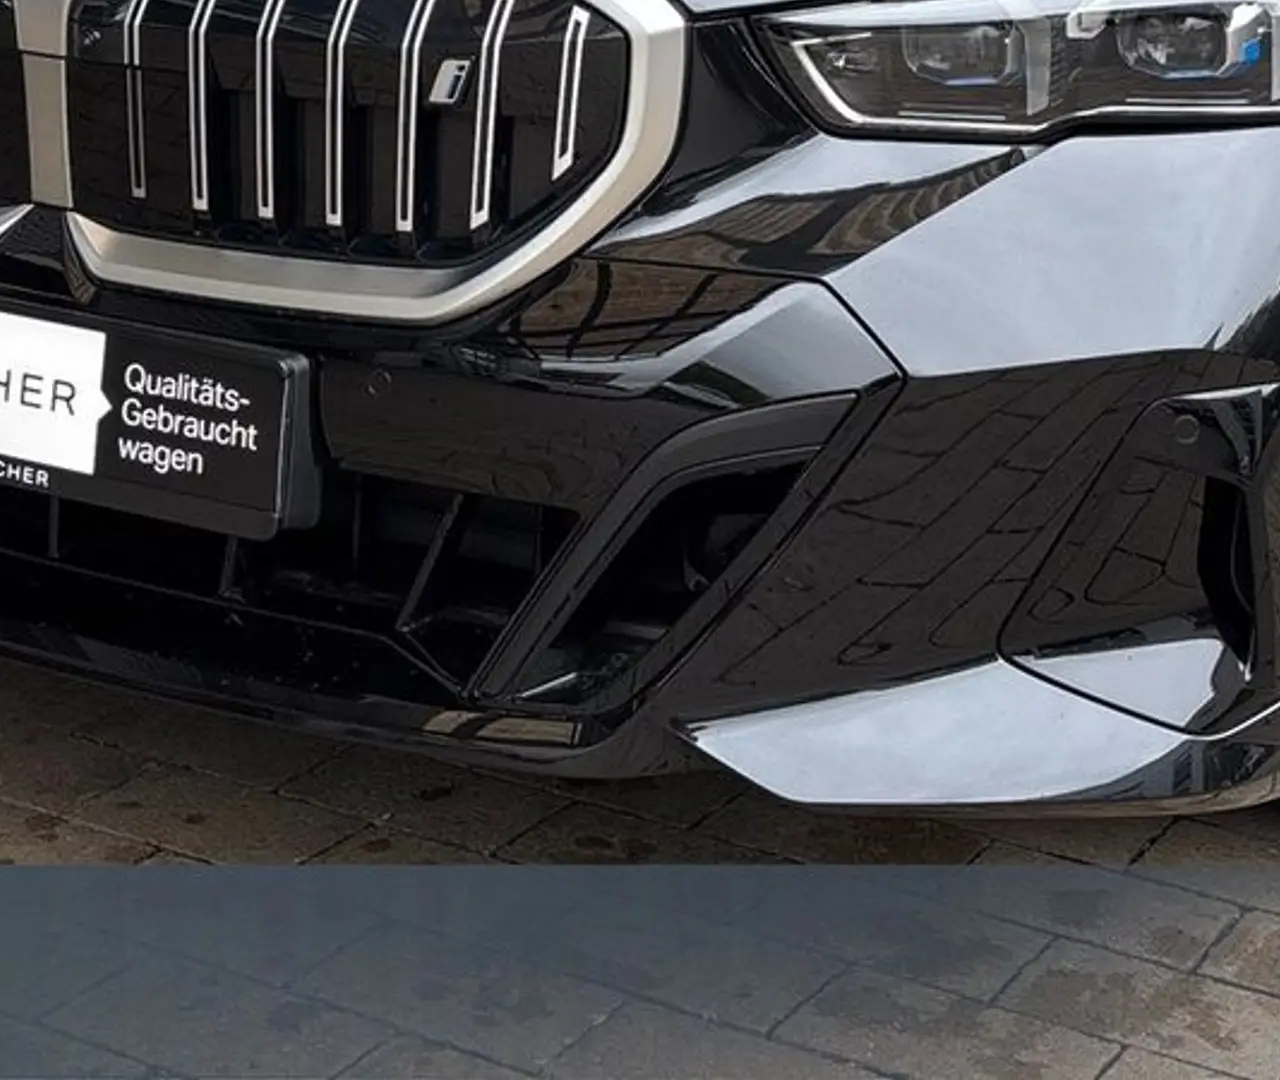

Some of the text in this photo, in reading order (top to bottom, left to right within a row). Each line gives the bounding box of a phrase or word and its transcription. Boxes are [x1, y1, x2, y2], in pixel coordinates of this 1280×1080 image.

[124, 362, 251, 412] Qualitäts-
[121, 397, 258, 451] Gebraucht
[118, 436, 203, 475] wagen
